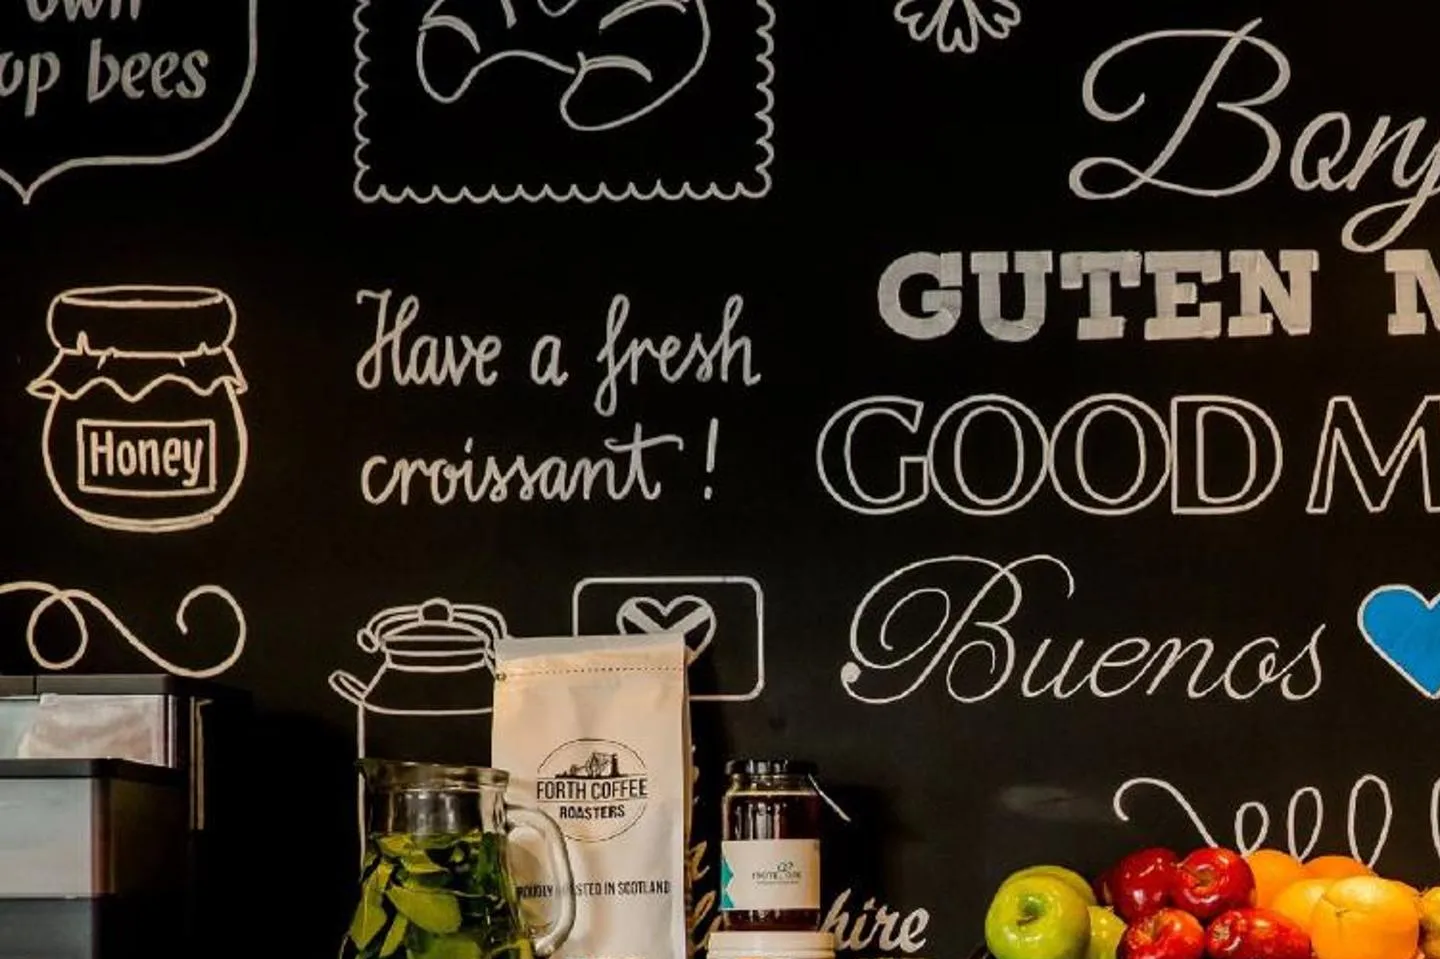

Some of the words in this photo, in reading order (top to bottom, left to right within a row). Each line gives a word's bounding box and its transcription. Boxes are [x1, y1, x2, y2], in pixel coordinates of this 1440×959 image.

[88, 39, 208, 102] bees
[878, 250, 1319, 342] GUTEN
[357, 290, 501, 388] Have
[531, 336, 568, 386] a
[595, 295, 761, 416] fresh
[90, 431, 203, 486] Honey
[816, 393, 1282, 515] GOOD
[840, 554, 1326, 703] Buenos
[537, 781, 586, 800] FORTH
[590, 779, 648, 799] COFFEE
[559, 805, 625, 820] ROASTERS
[604, 882, 614, 895] IN
[617, 880, 671, 895] SCOTLAND
